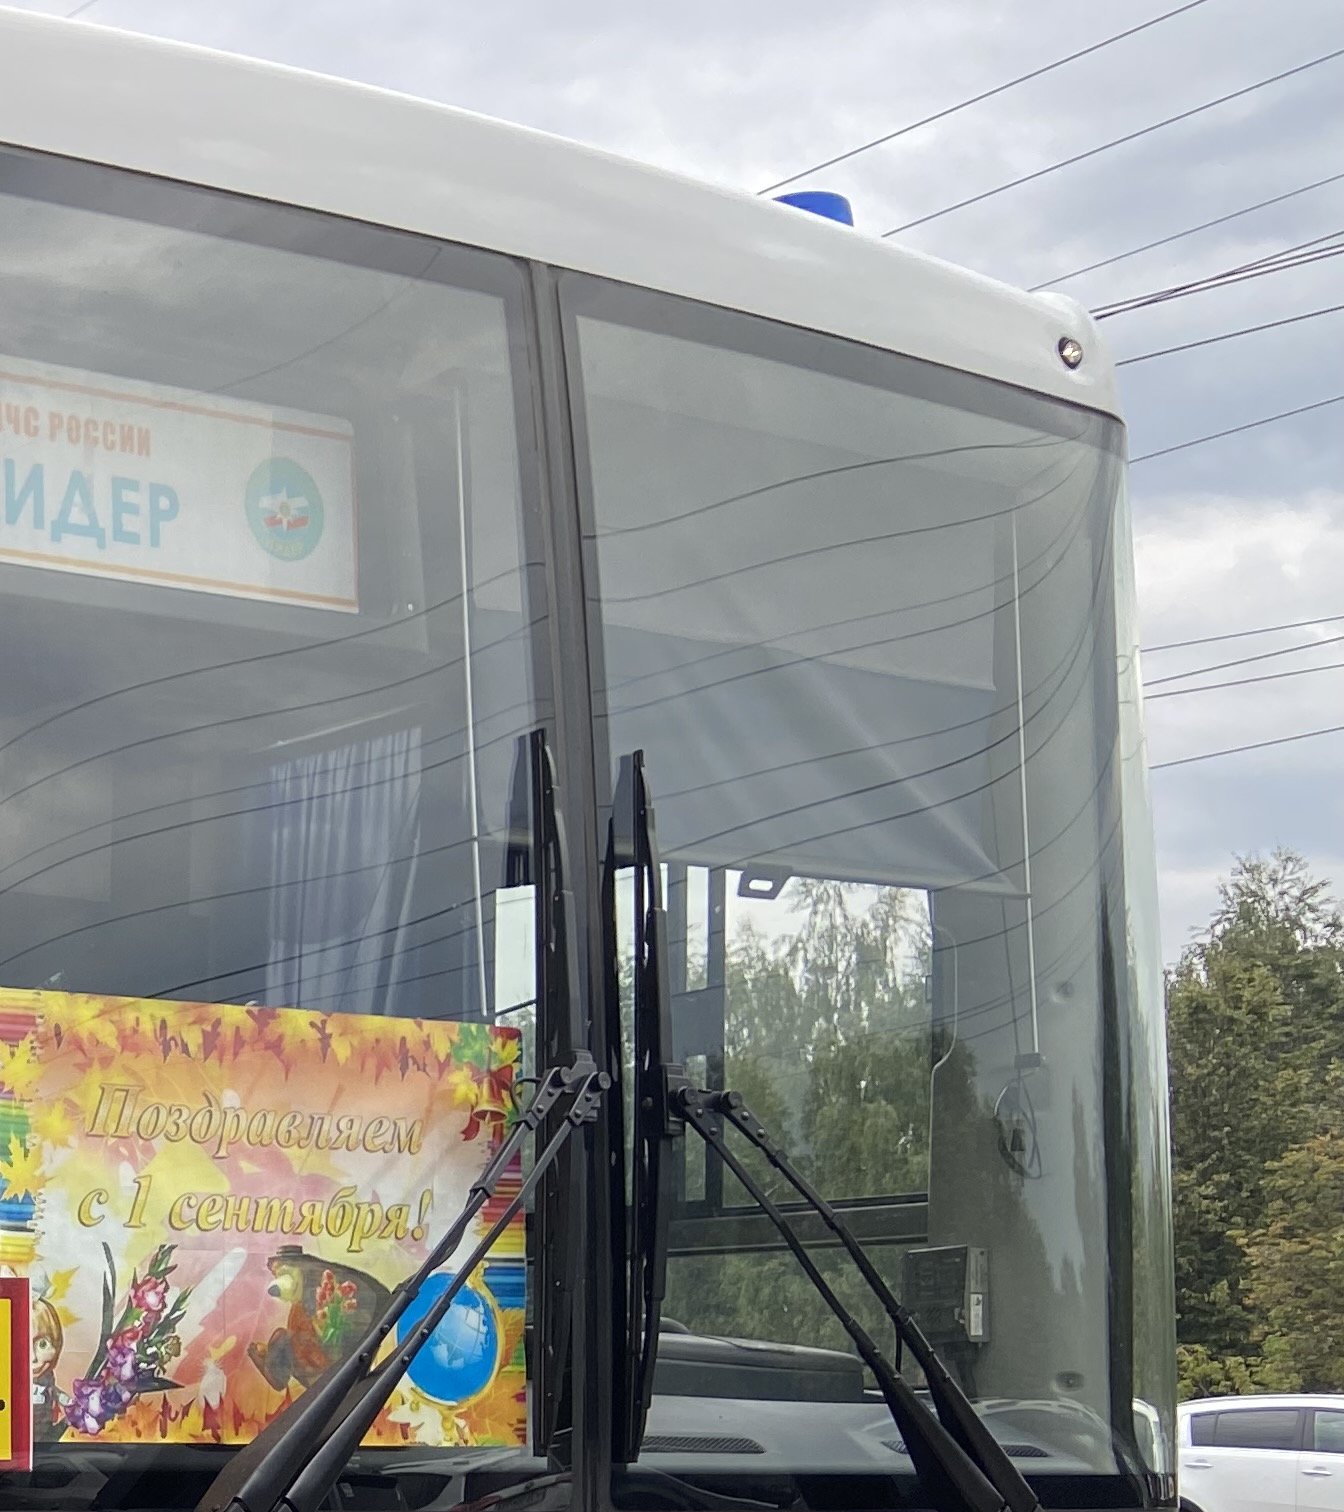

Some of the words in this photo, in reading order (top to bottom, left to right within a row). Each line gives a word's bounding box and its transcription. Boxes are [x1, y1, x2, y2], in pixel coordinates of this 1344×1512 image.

[48, 411, 153, 458] РОССИИ
[87, 1083, 424, 1160] Поздравляем
[77, 1188, 110, 1228] с
[123, 1173, 155, 1229] 1
[168, 1185, 434, 1253] сентября!
